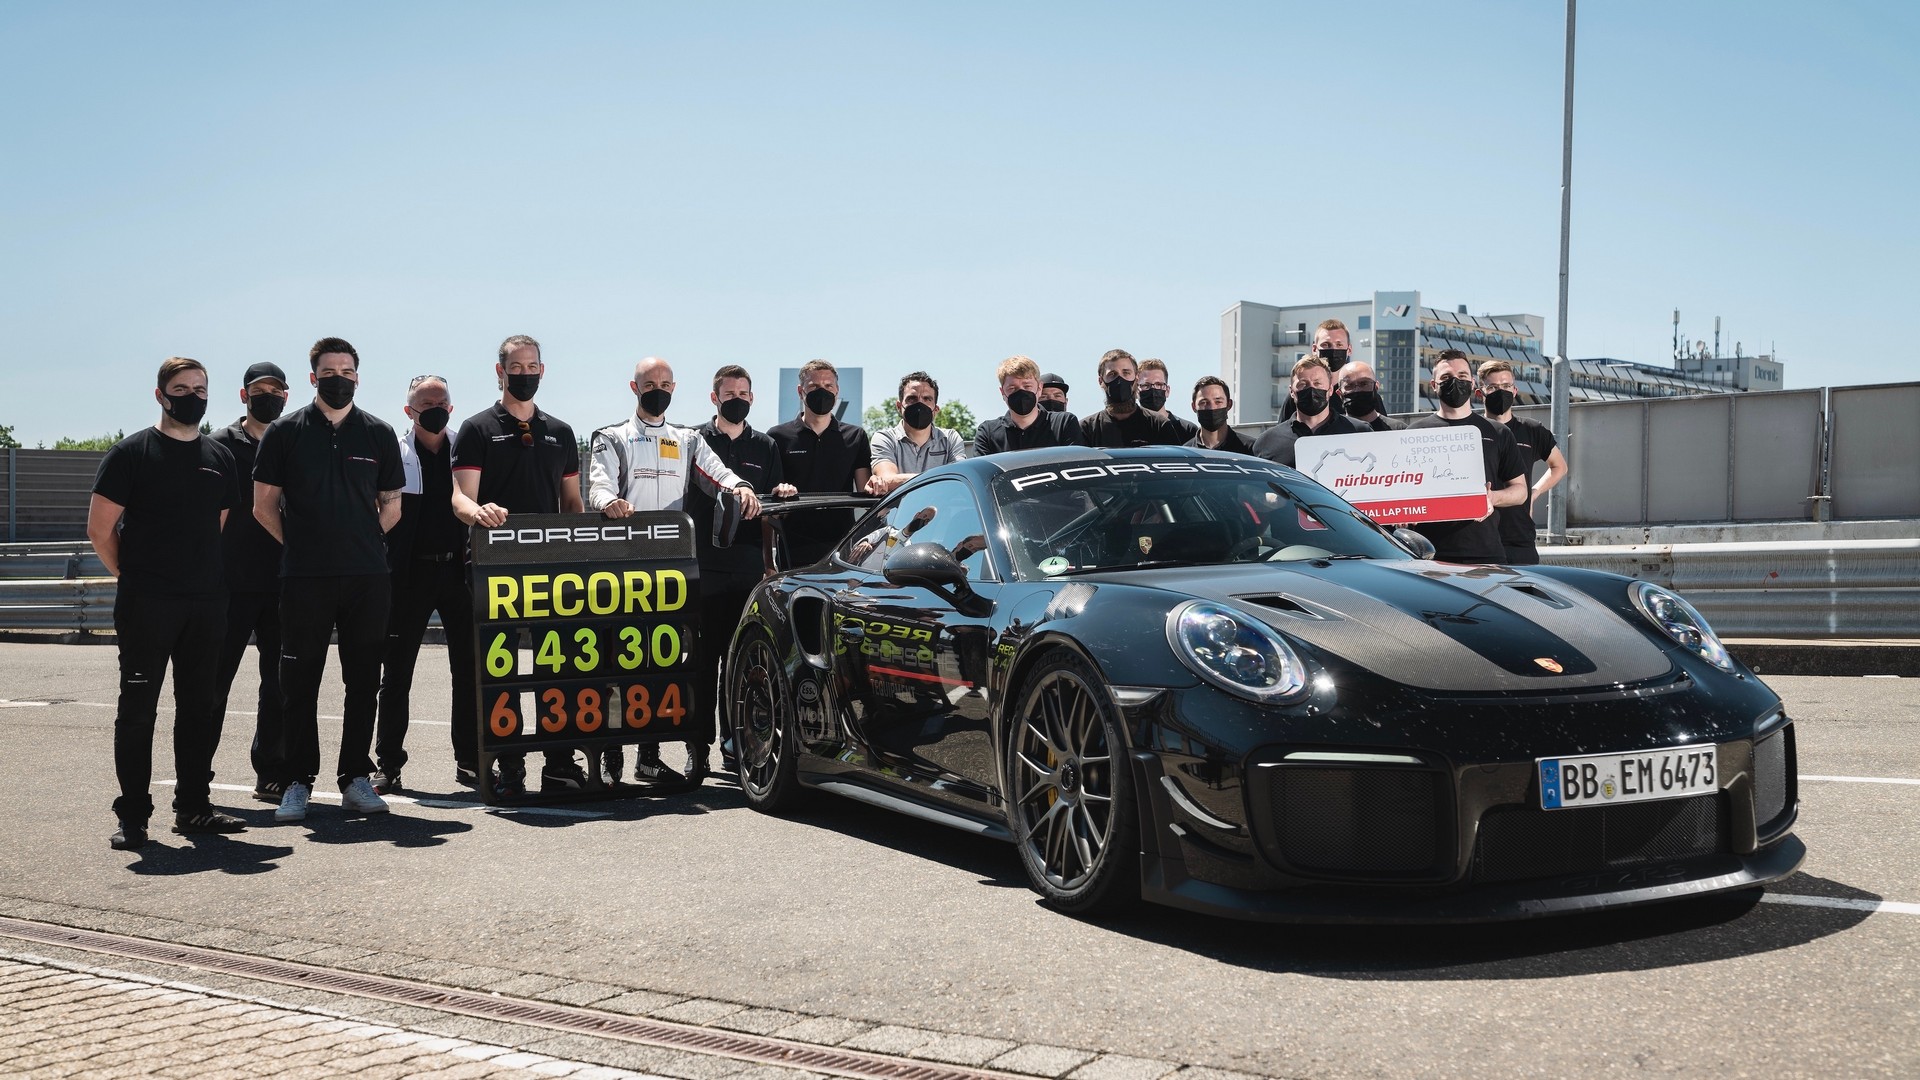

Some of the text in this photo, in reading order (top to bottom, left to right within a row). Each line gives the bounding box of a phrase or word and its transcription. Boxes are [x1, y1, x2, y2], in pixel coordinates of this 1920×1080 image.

[1400, 432, 1475, 445] NORDSCHLEIFE
[1410, 443, 1476, 456] SPORTS CARS
[1391, 453, 1399, 469] 6
[1010, 462, 1310, 492] PORSCHE
[1334, 470, 1424, 488] nürburgring
[1382, 508, 1402, 517] LAP
[1403, 506, 1427, 515] TIME
[488, 524, 680, 545] PORSCHE
[1049, 558, 1058, 566] 4
[487, 569, 688, 620] RECORD
[486, 624, 681, 678] 6 43 30
[801, 684, 817, 695] Esso
[490, 683, 686, 737] 6 38 84
[1562, 751, 1715, 800] BB EM 6473
